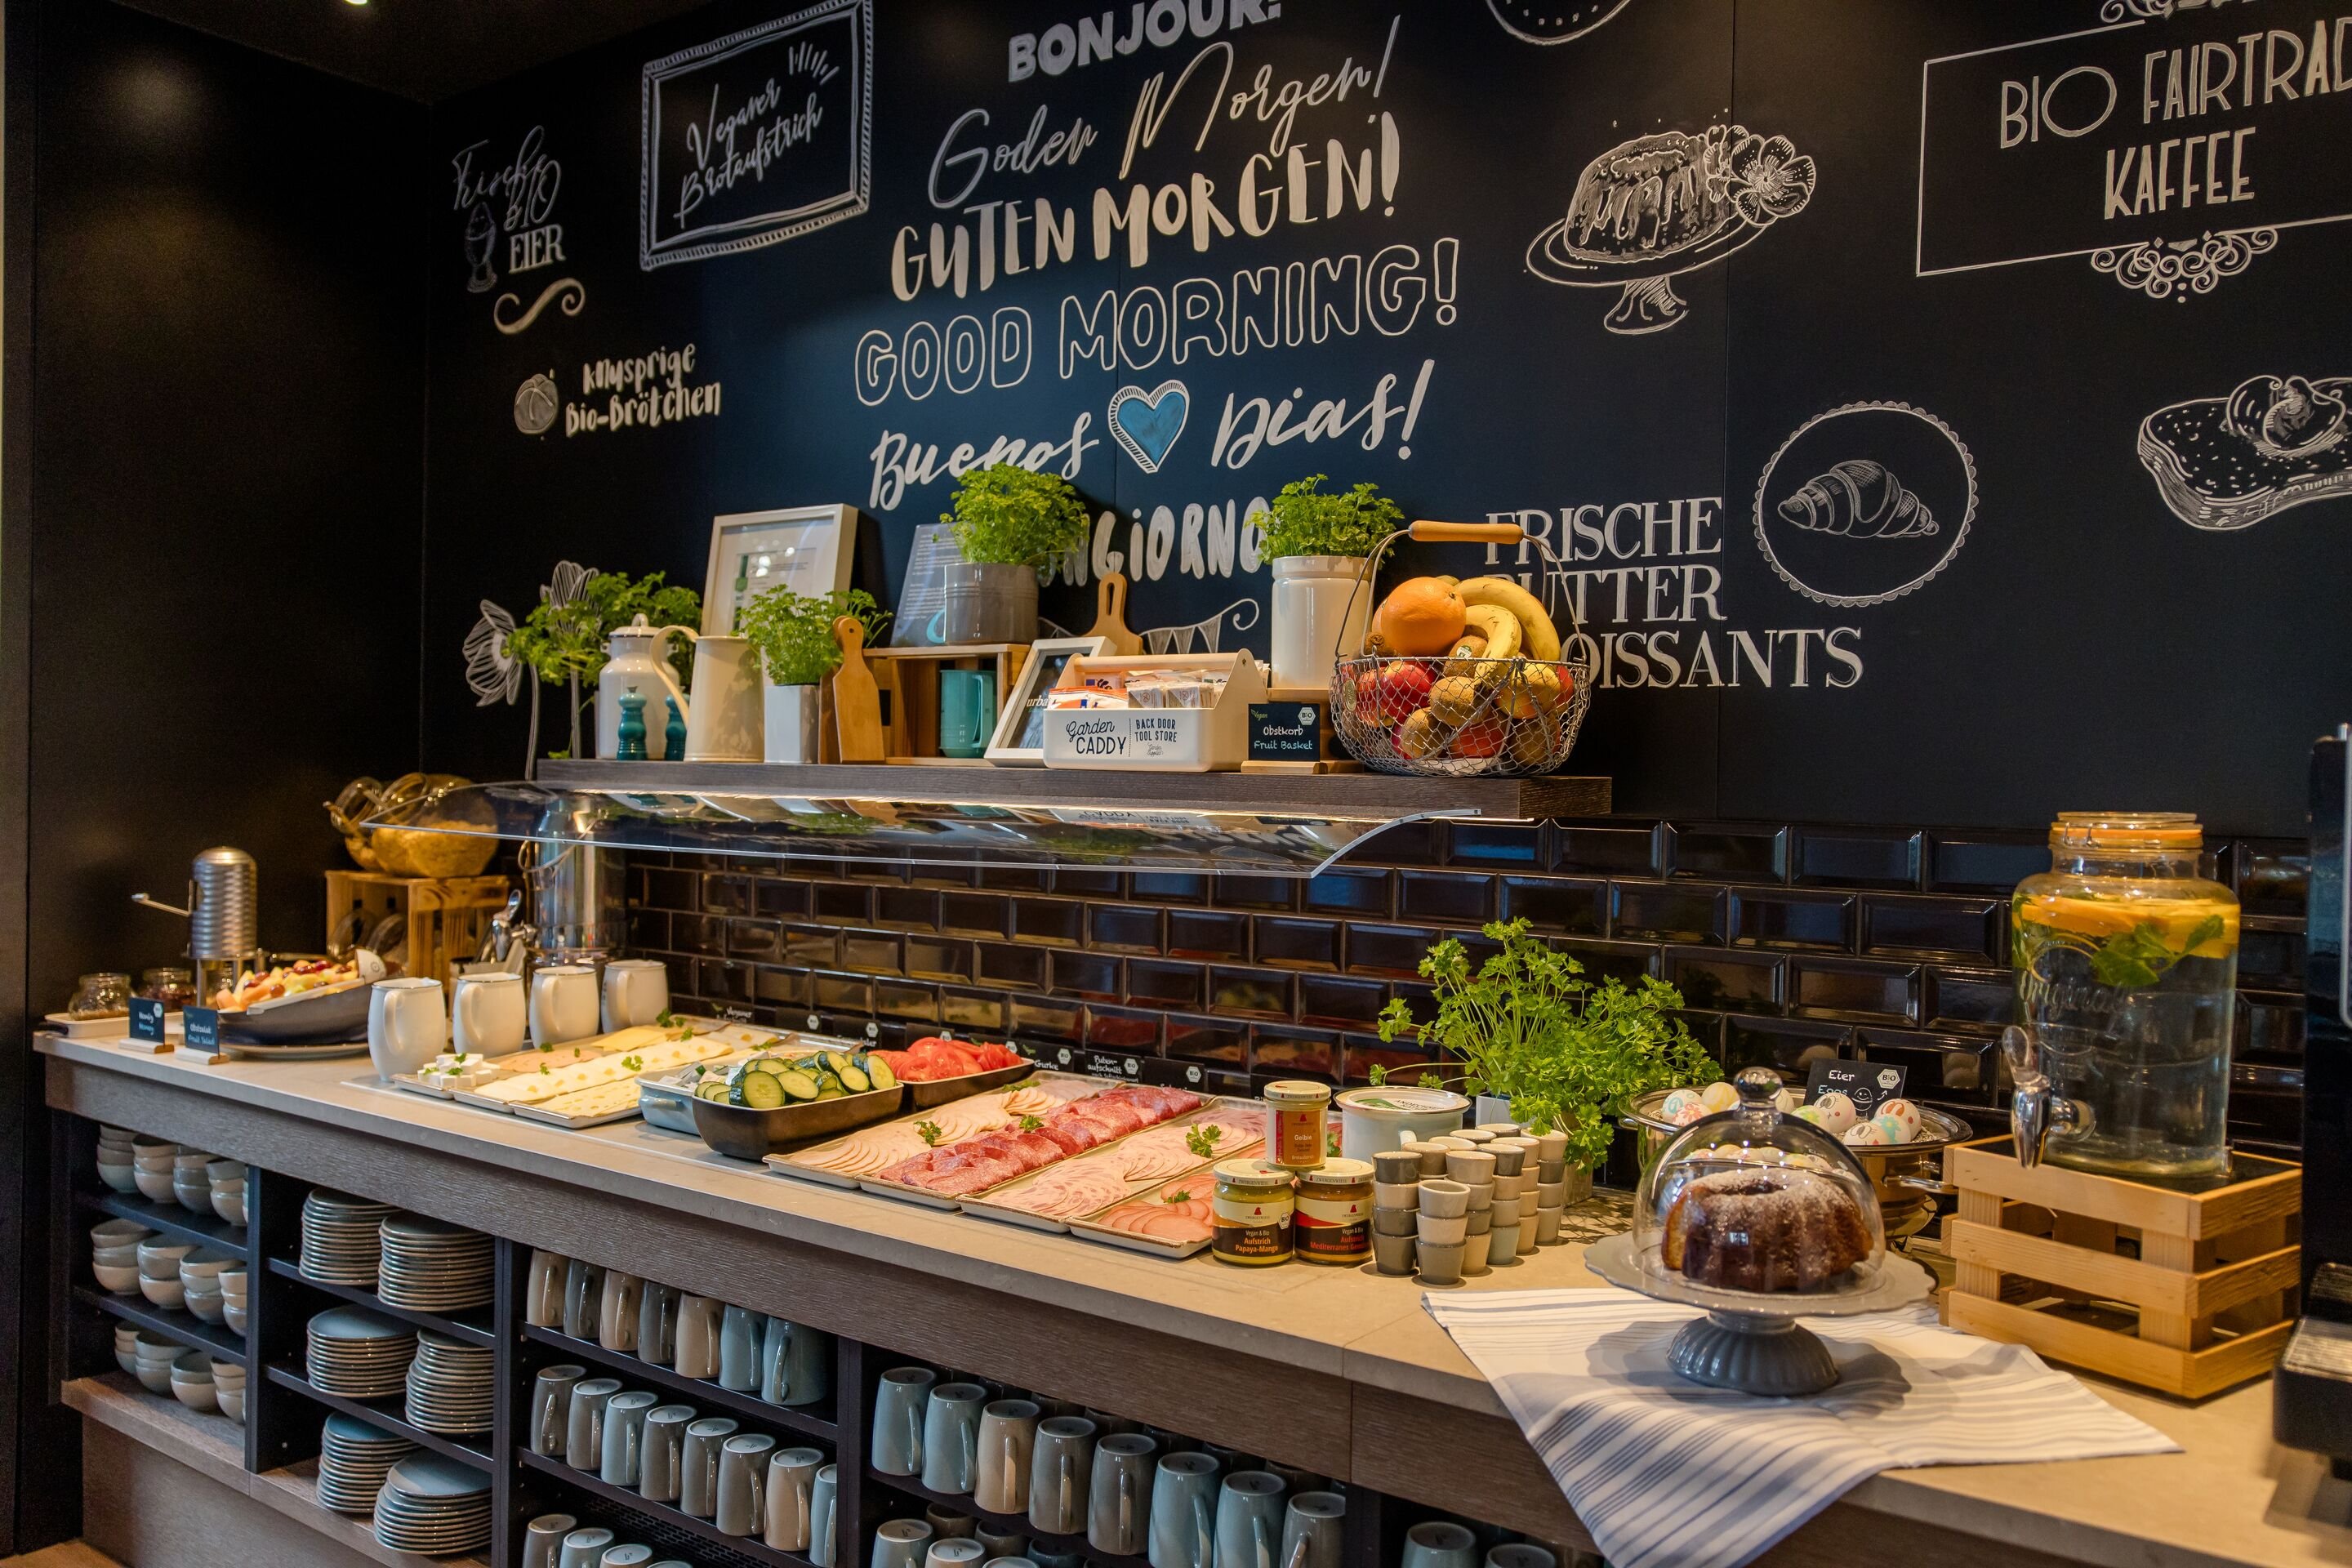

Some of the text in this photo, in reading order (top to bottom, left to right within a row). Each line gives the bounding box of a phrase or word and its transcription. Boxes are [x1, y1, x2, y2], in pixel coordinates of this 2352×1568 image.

[928, 14, 1401, 209] Goden Morgen!
[2000, 66, 2118, 149] BIO
[686, 83, 781, 169] Veganer
[674, 92, 823, 229] Brotaufstrich
[2104, 127, 2256, 220] KAFFEE
[891, 111, 1401, 301] GUTEN MORGEN!
[509, 223, 567, 274] EIER
[854, 237, 1459, 407] GOOD MORNING!
[869, 359, 1436, 511] Buenos Dias!
[1485, 497, 1723, 565] FRISCHE
[1482, 564, 1727, 626] UTTER
[1561, 626, 1864, 688] OISSANTS
[1067, 718, 1115, 742] Garden
[1134, 730, 1178, 742] TOOL STORE
[1136, 719, 1176, 729] BACK DOOR
[1263, 724, 1303, 736] Obstkorb
[1076, 737, 1126, 755] CADDY
[1254, 740, 1313, 750] Fruit Basket
[1034, 1059, 1059, 1071] Gurke
[1087, 1063, 1123, 1075] aufschnitt
[1829, 1069, 1855, 1082] Eier
[1245, 1230, 1259, 1238] Vegan
[1342, 1227, 1355, 1236] Vegan
[1235, 1244, 1278, 1254] Papaya-Mango
[1310, 1241, 1348, 1251] Mediterranes
